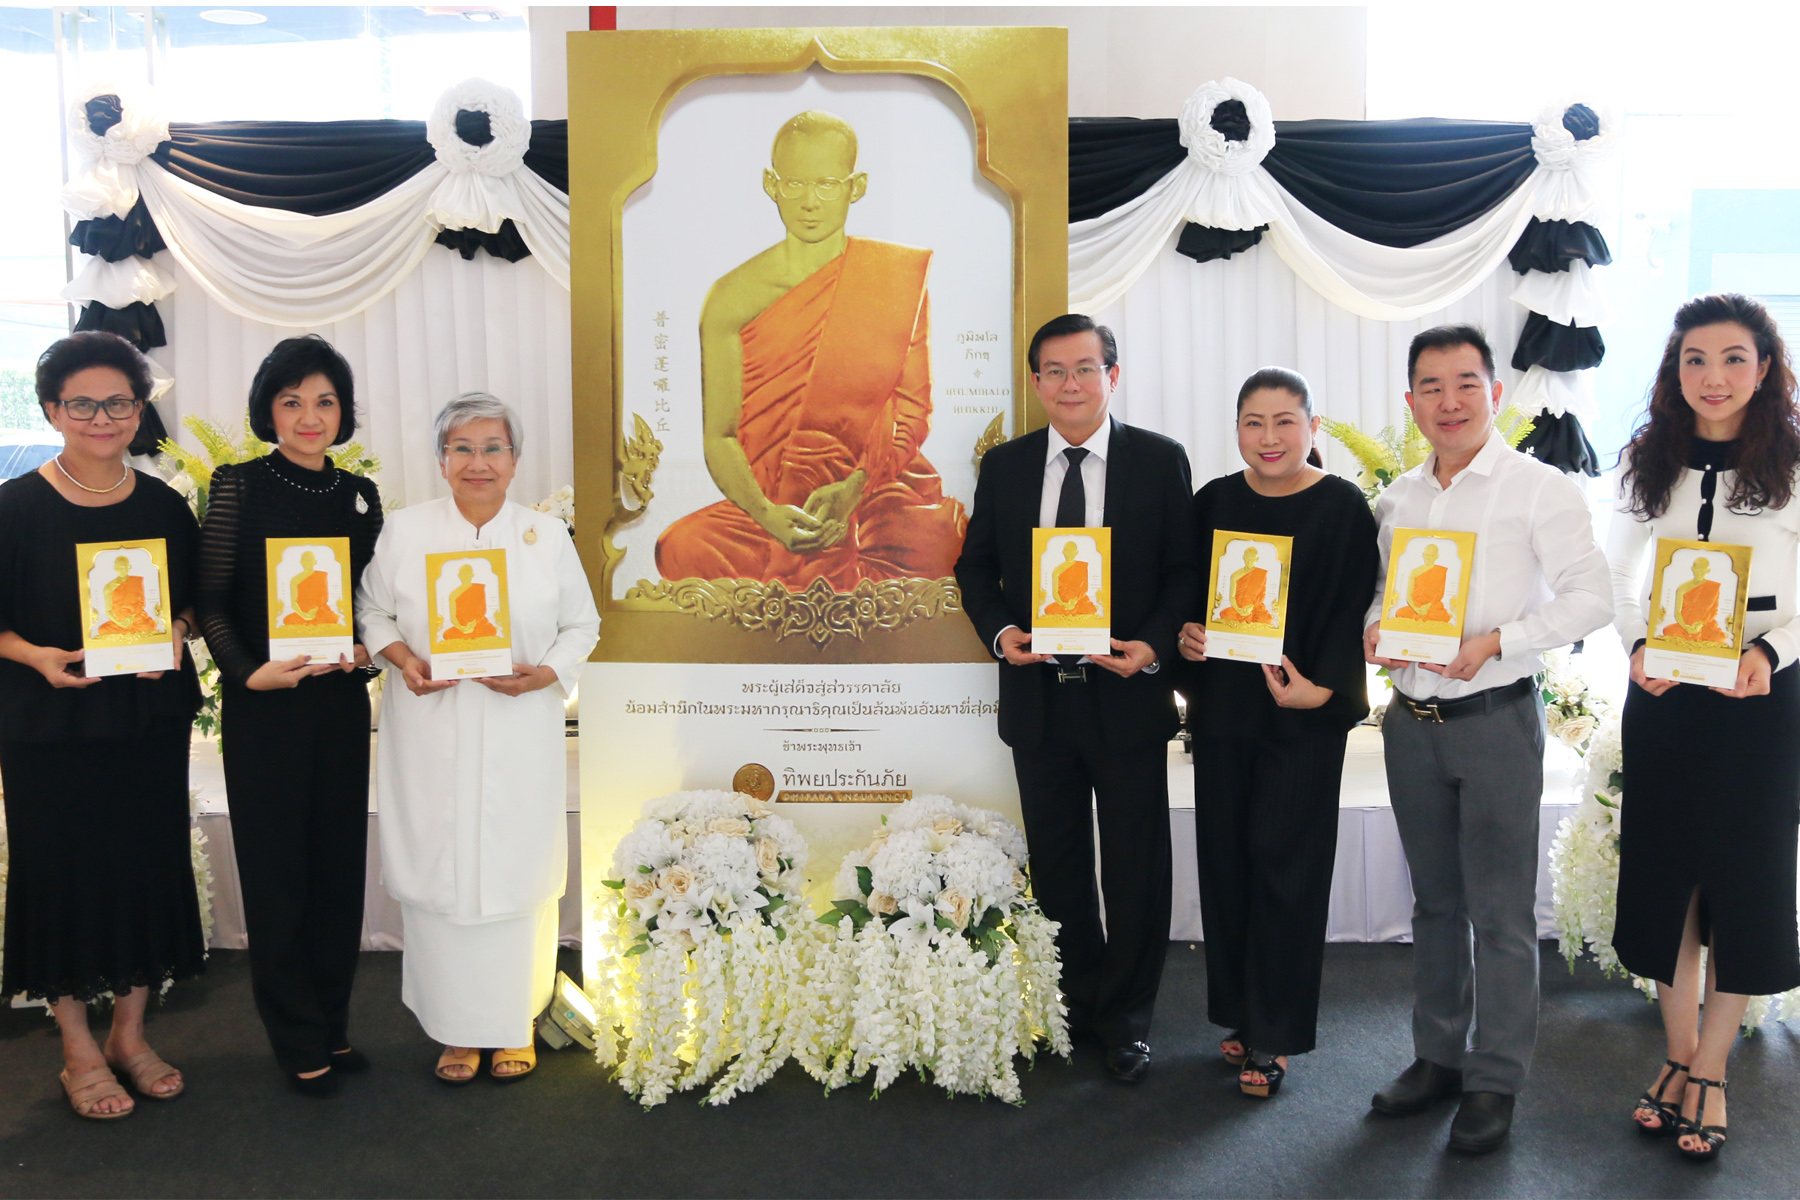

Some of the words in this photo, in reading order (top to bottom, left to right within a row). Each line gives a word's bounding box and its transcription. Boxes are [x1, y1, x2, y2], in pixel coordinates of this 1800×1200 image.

[782, 739, 862, 754] ข้าพระพุทธเจ้า
[782, 766, 907, 787] ทิพยประกันภัย
